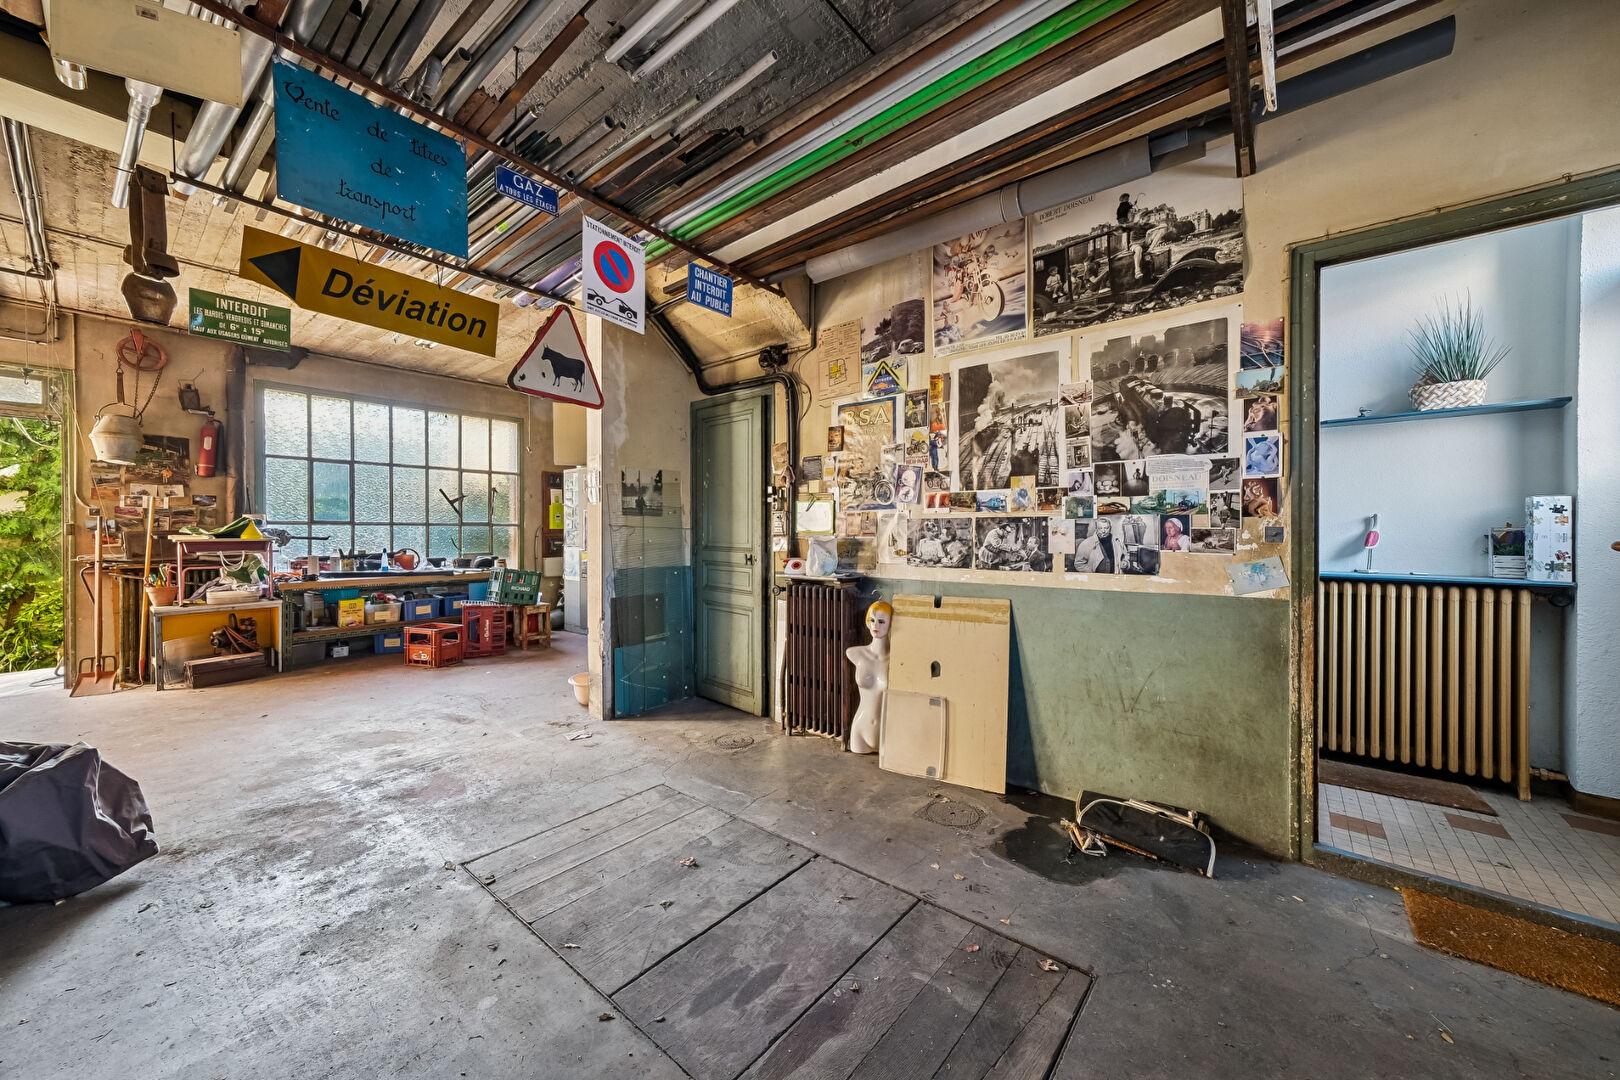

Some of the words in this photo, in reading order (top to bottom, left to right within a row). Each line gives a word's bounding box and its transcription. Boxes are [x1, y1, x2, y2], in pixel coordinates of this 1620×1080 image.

[283, 80, 341, 122] Vente
[367, 121, 389, 142] de
[409, 137, 448, 167] titres
[370, 157, 393, 178] de
[504, 186, 521, 198] TOUS
[523, 193, 533, 203] LES
[513, 174, 544, 199] GAZ
[336, 178, 417, 222] transport
[694, 267, 728, 289] CHANTIER
[694, 278, 727, 300] INTERDIT
[216, 297, 268, 318] INTERDIT
[321, 268, 487, 338] Déviation
[690, 290, 702, 303] AU
[705, 295, 730, 314] PUBLIC
[206, 328, 217, 336] AUX
